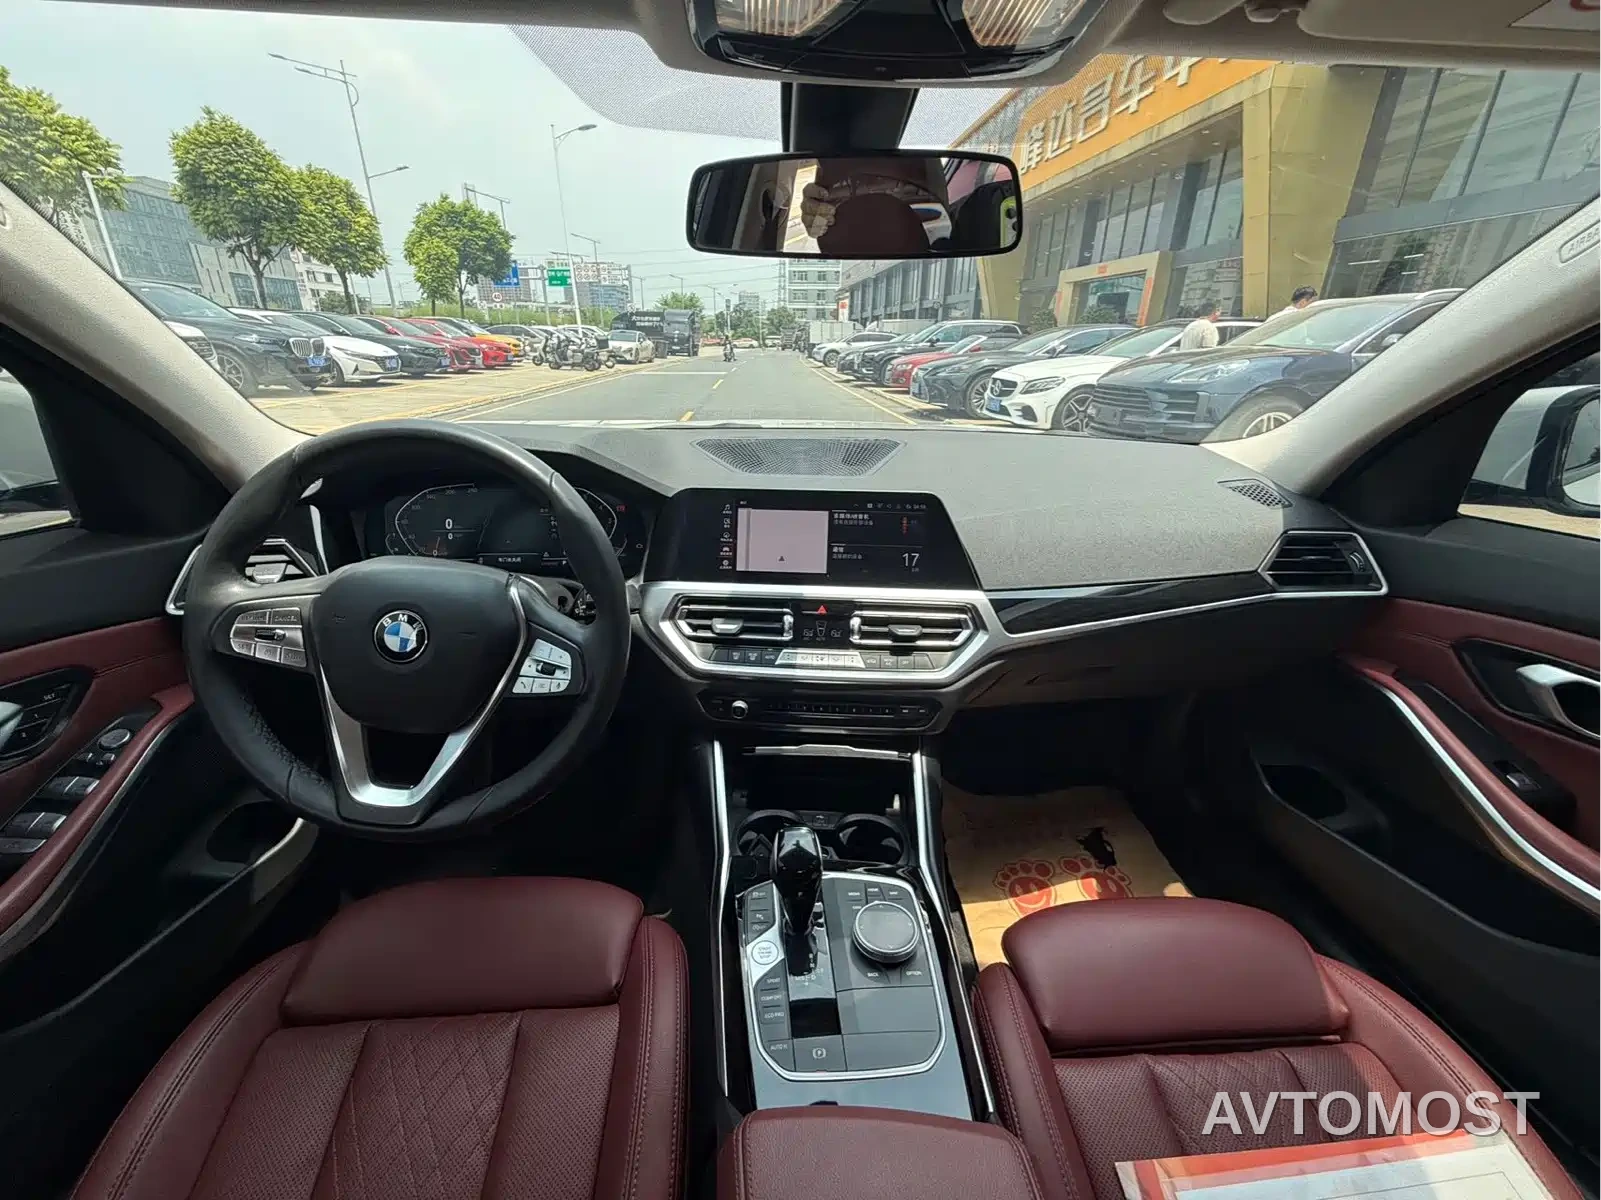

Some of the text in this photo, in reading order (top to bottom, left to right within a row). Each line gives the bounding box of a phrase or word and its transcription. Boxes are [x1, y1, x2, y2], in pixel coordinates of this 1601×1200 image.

[445, 518, 453, 530] 0
[448, 532, 453, 540] 0
[902, 552, 920, 567] 17
[383, 613, 423, 631] BMW
[43, 693, 56, 701] SET
